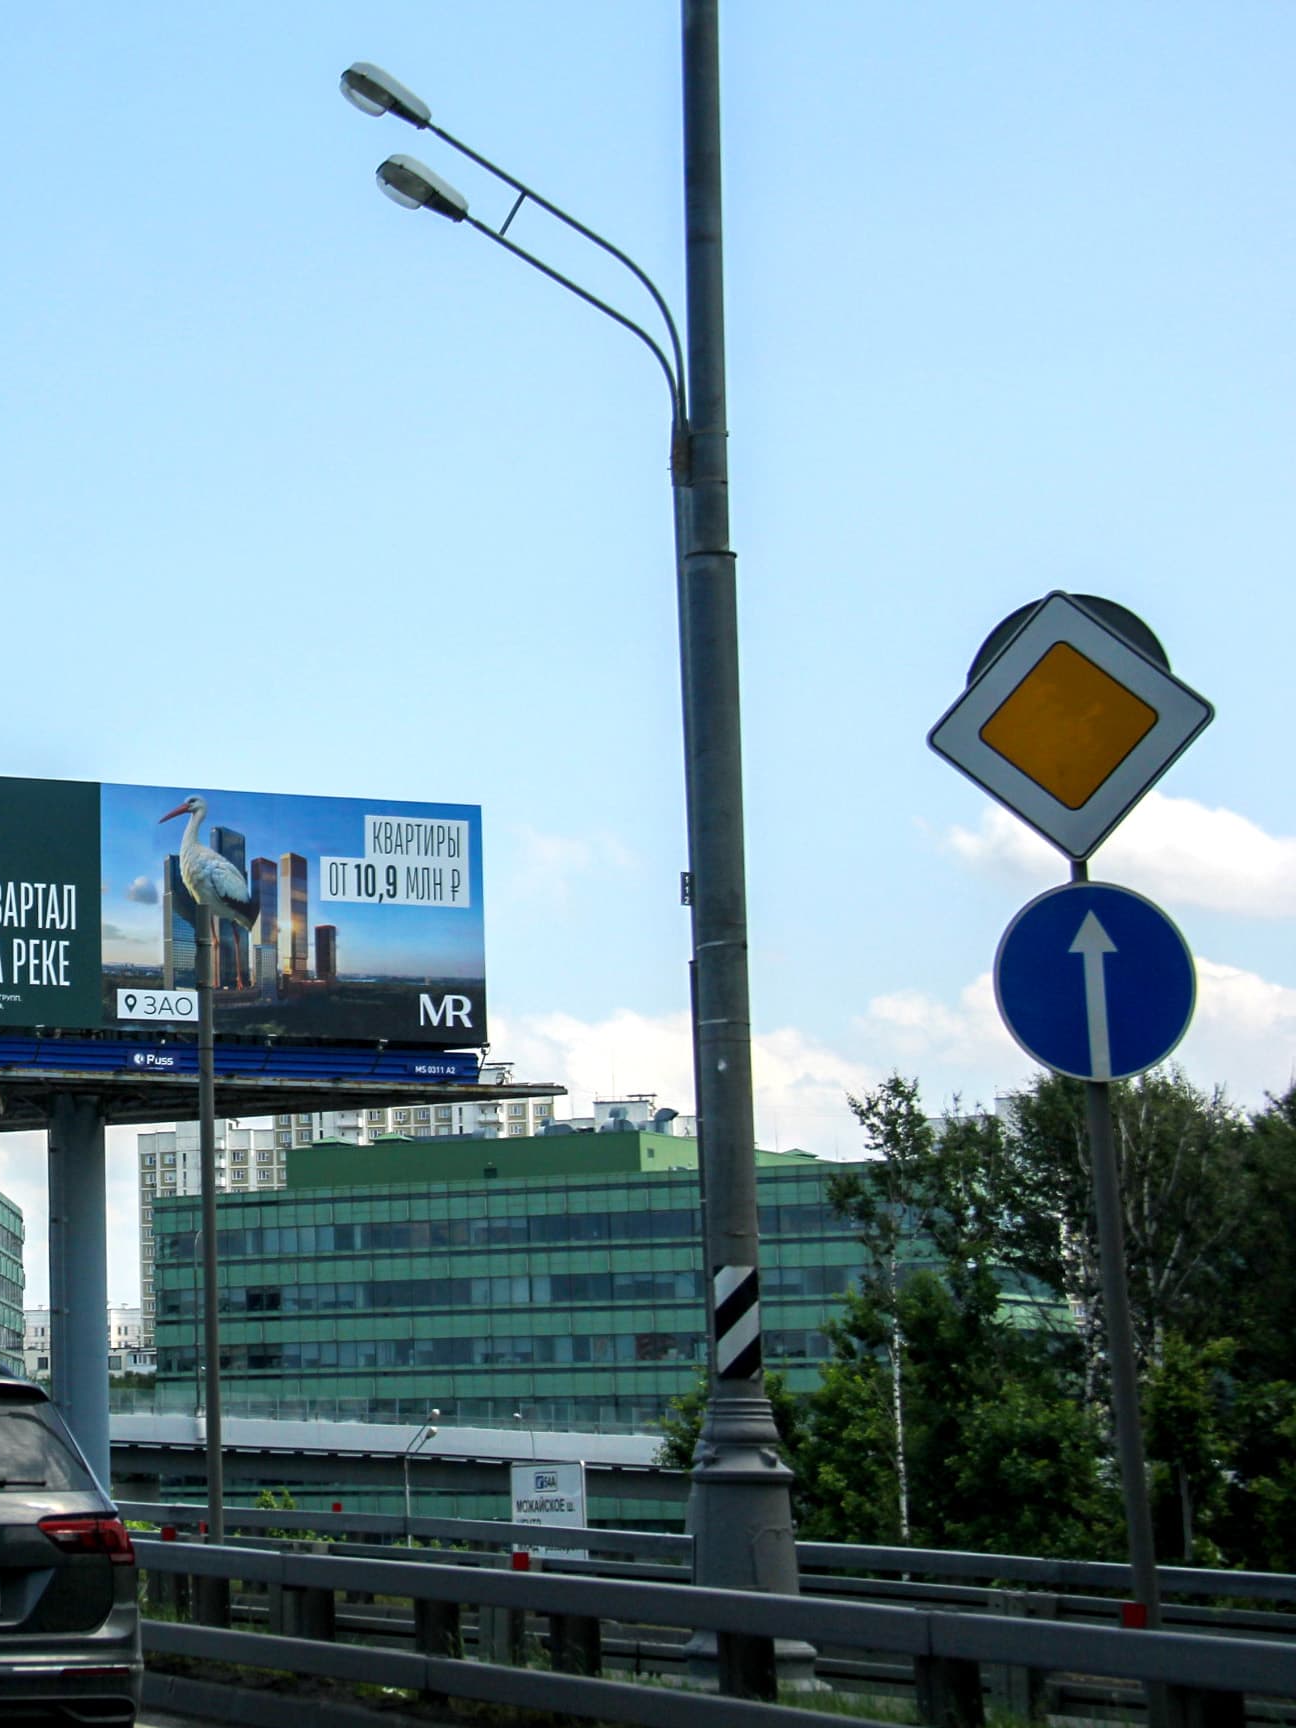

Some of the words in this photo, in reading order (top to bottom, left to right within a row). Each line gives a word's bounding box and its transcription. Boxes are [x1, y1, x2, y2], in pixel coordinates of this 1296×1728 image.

[373, 821, 460, 858] КВАРТИРЫ
[329, 862, 348, 897] ОТ
[355, 863, 397, 904] 10,9
[406, 866, 443, 901] МЛН
[12, 938, 70, 986] РЕКЕ
[144, 996, 193, 1016] ЗАО
[419, 993, 473, 1028] MR
[516, 1496, 565, 1512] МОЖАЙСКОЕ
